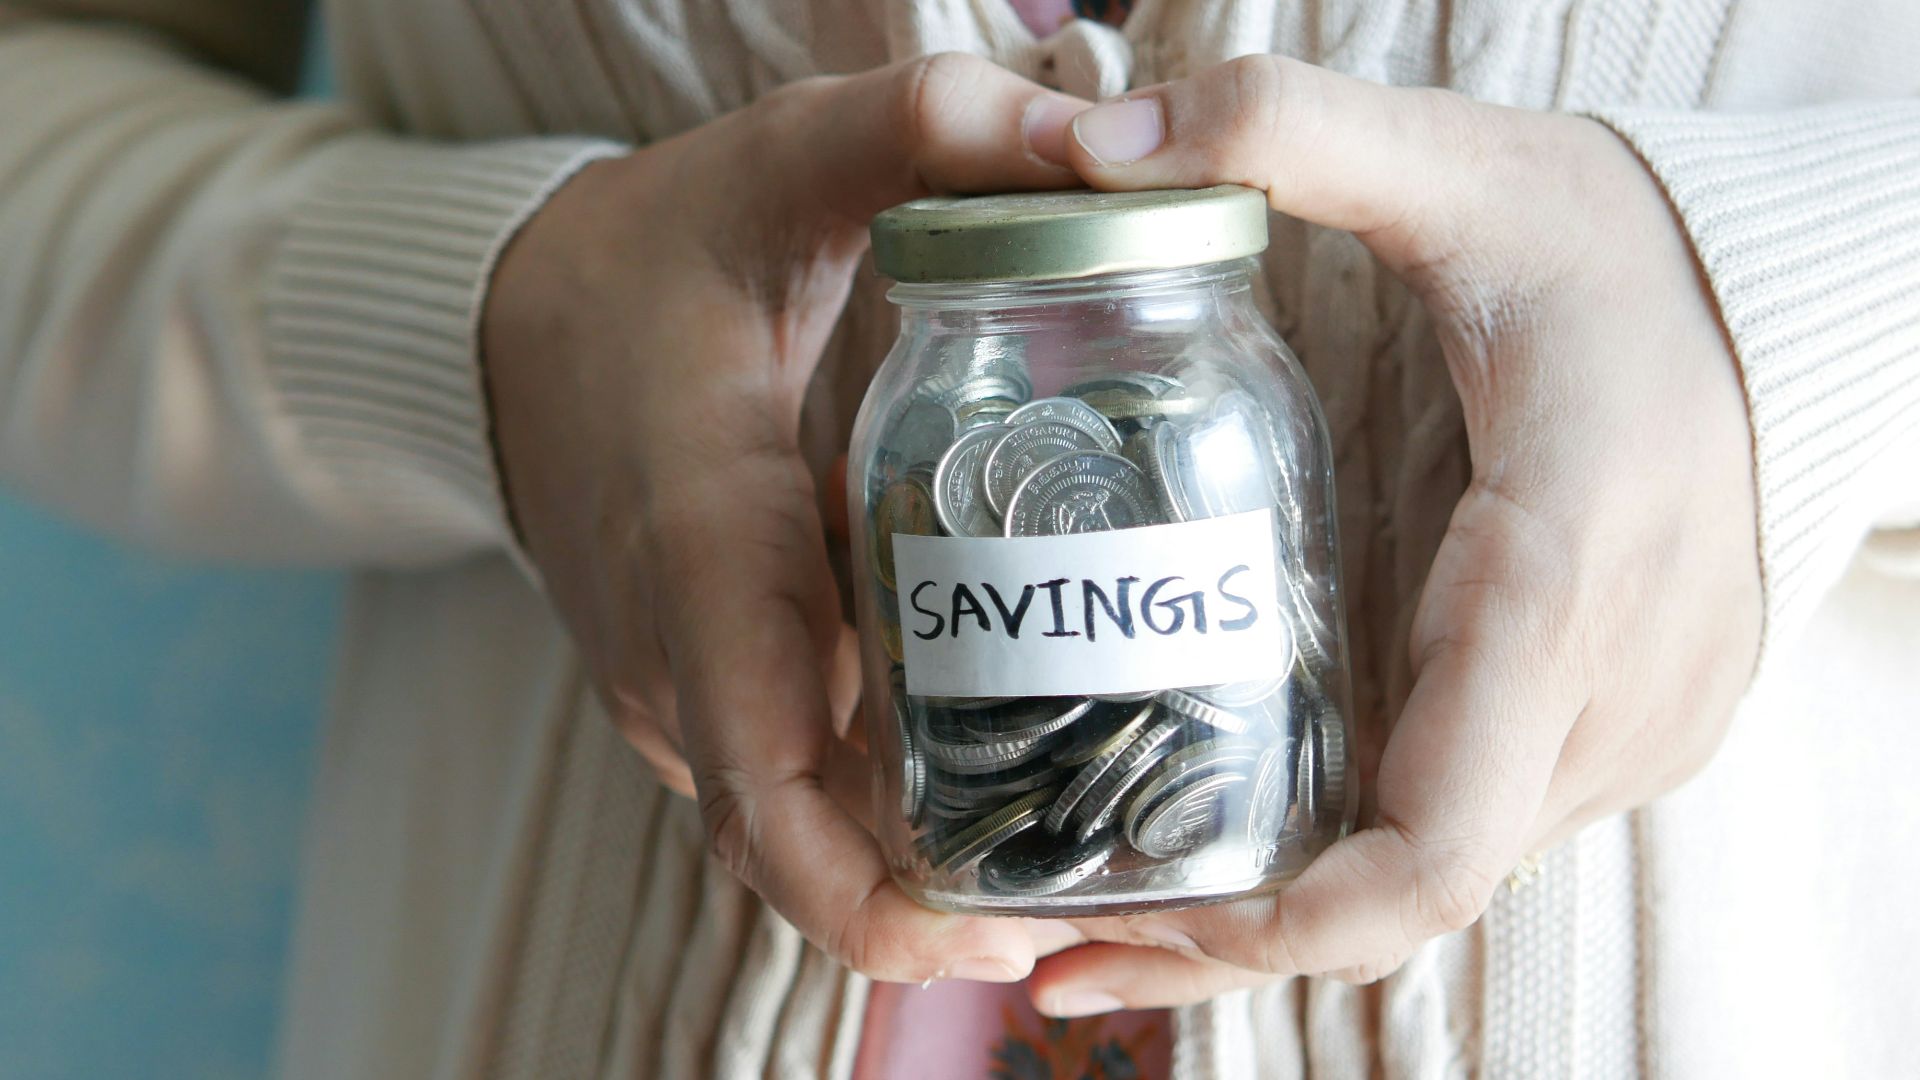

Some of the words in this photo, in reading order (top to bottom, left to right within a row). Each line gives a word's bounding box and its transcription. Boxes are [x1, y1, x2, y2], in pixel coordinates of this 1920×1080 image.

[1008, 425, 1078, 448] SINGAPURA
[951, 471, 965, 508] CENTS
[910, 565, 1258, 642] SAVINGS
